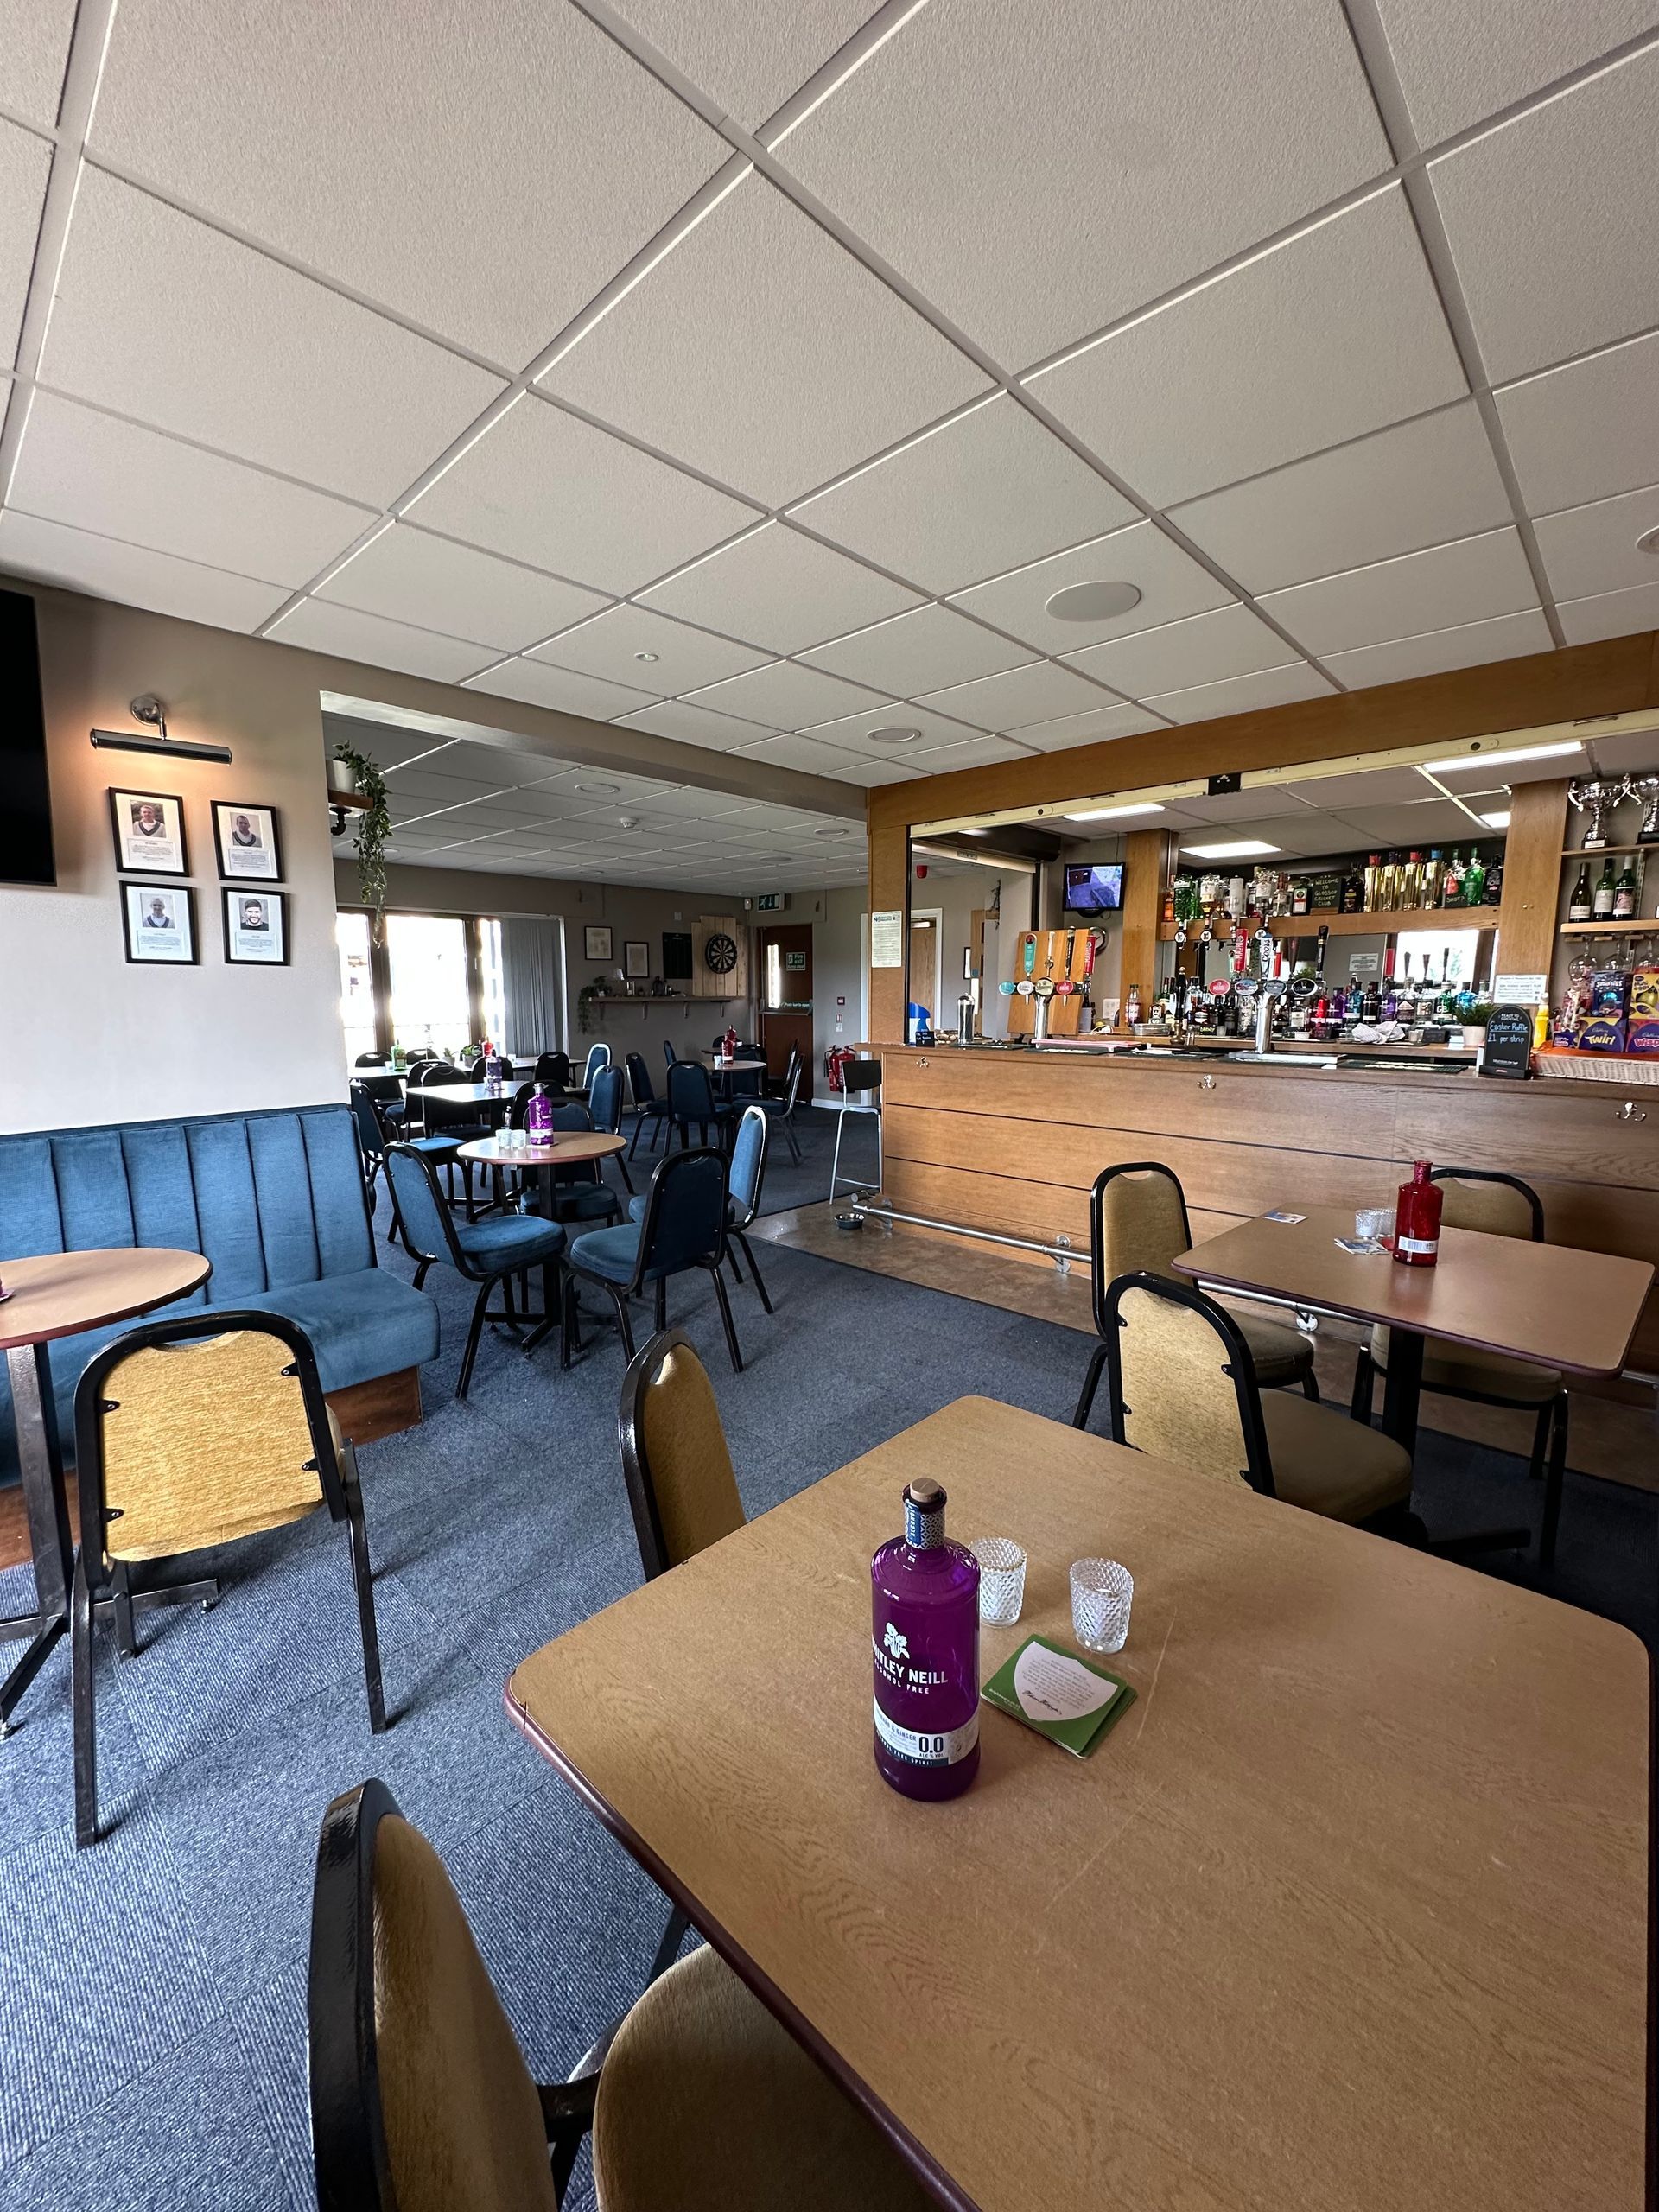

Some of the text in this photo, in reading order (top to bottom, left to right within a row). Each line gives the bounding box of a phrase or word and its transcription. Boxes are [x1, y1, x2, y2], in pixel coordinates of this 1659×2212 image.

[1490, 1020, 1529, 1031] Easter Raffle
[1510, 1035, 1525, 1044] strip
[908, 1669, 948, 1685] NEILL
[906, 1684, 930, 1694] FREE
[896, 1728, 917, 1742] GINGER
[918, 1736, 944, 1753] 0.0
